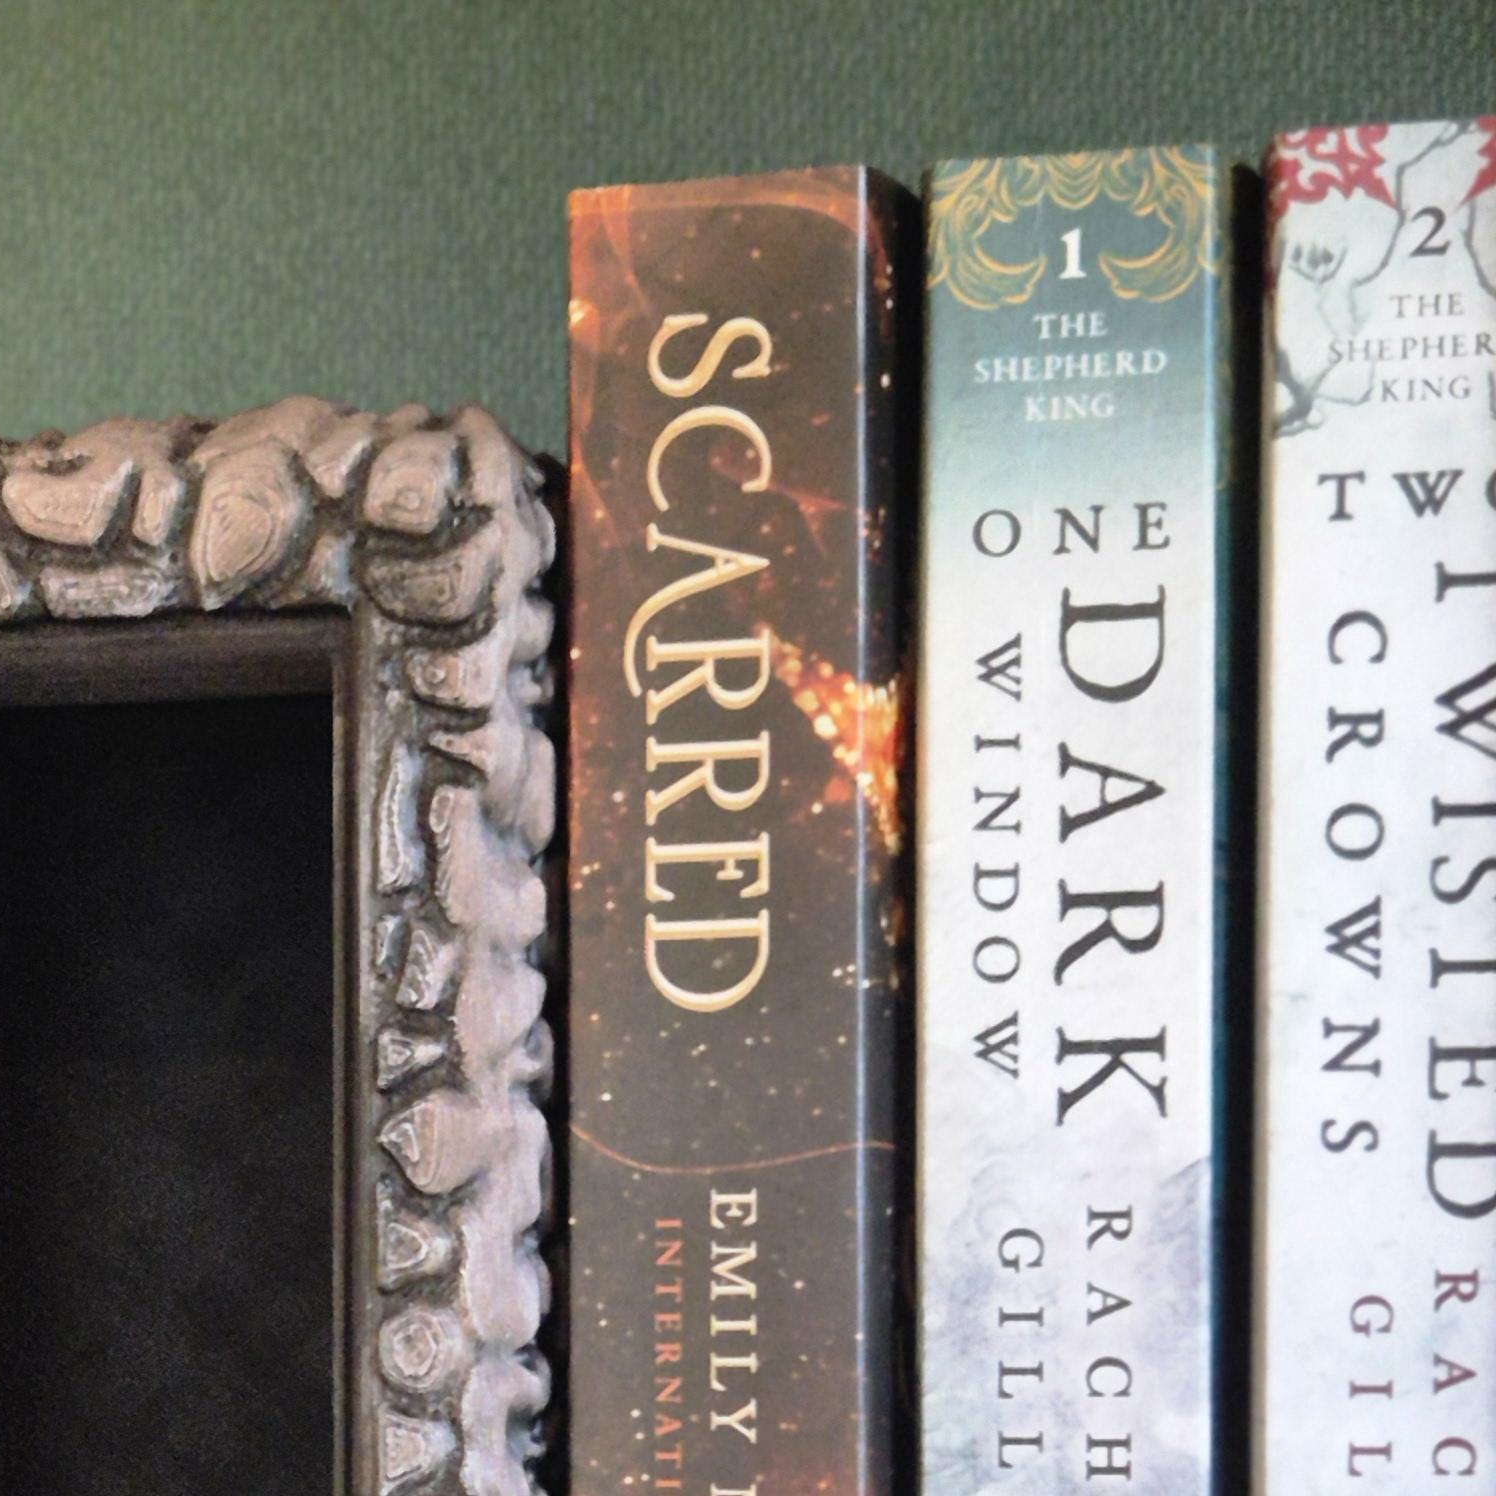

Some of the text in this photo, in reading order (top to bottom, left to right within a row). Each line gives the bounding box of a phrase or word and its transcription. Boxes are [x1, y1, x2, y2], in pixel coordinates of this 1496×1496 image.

[1056, 228, 1089, 281] 1
[1408, 206, 1451, 258] 2
[1033, 311, 1108, 341] THE
[1389, 292, 1465, 319] THE
[973, 347, 1168, 386] SHEPHERD
[1327, 332, 1496, 364] SHEPHER
[1023, 392, 1117, 424] KING
[1380, 375, 1473, 402] KING
[1317, 469, 1496, 522] TW
[972, 502, 1173, 558] ONE
[625, 313, 774, 1013] SCARRED
[972, 633, 1023, 1079] WINDOW
[1053, 584, 1168, 1127] DARK
[1321, 610, 1388, 1153] CROWNS
[709, 1188, 759, 1444] EMILY
